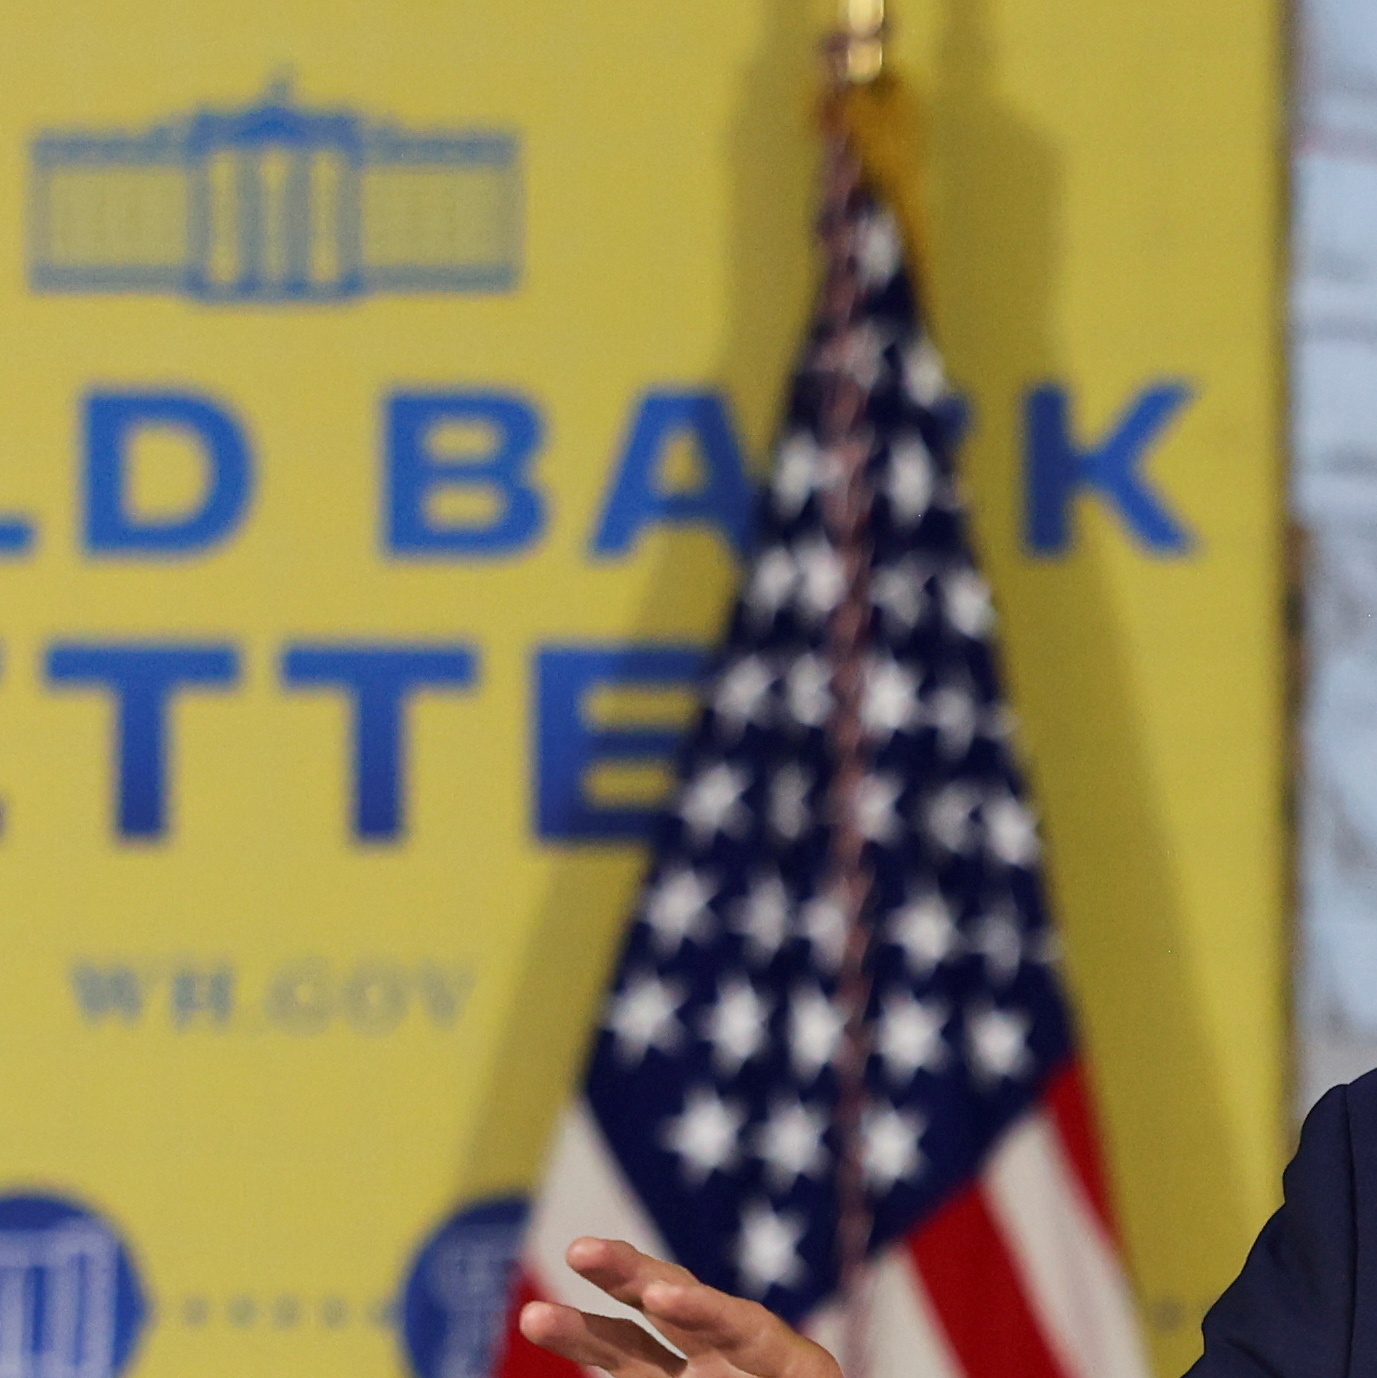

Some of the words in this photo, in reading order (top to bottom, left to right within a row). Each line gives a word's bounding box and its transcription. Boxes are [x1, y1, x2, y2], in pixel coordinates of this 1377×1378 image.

[0, 380, 260, 560] D
[376, 378, 1200, 562] BAK
[0, 636, 712, 848] TTE
